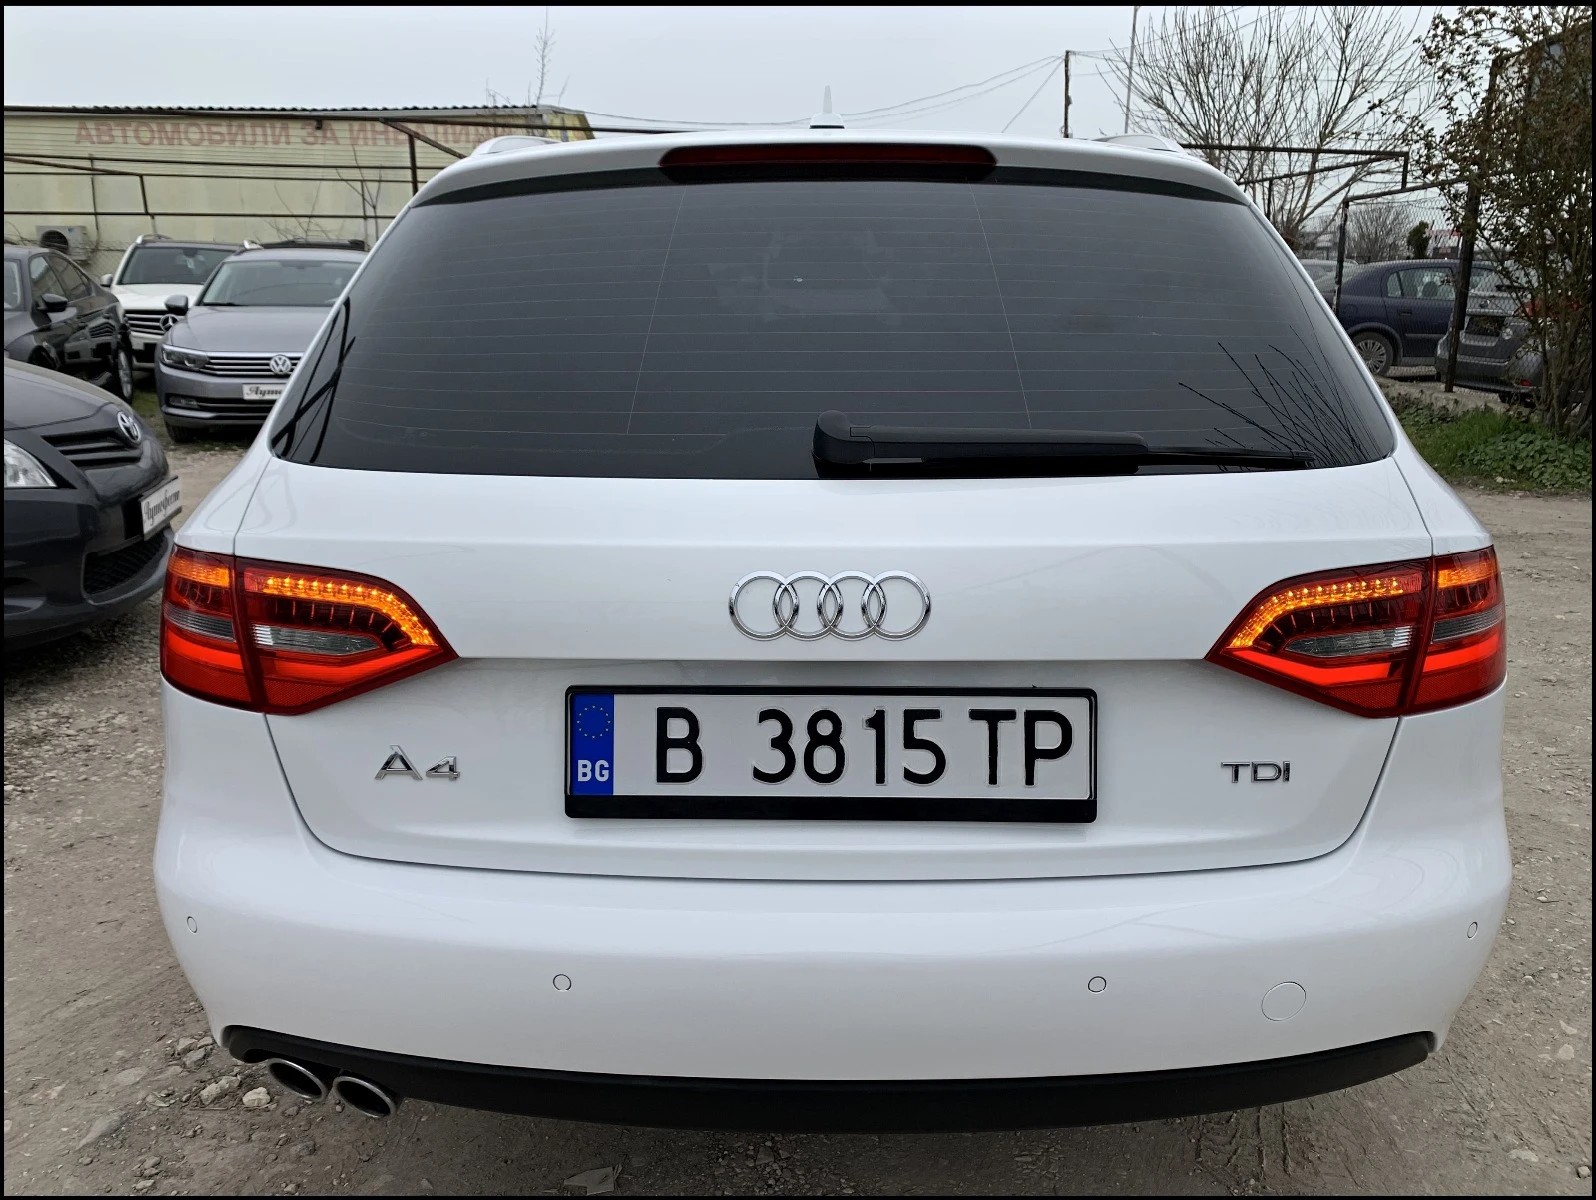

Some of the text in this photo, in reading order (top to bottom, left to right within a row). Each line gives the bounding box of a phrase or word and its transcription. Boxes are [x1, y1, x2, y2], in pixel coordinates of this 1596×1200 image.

[74, 120, 291, 146] АВТОМОБИЛИ
[301, 121, 340, 146] ЗА
[656, 706, 1073, 786] B 3815 TP
[374, 744, 460, 781] A4
[577, 760, 609, 782] BG
[1220, 760, 1291, 783] TDI
